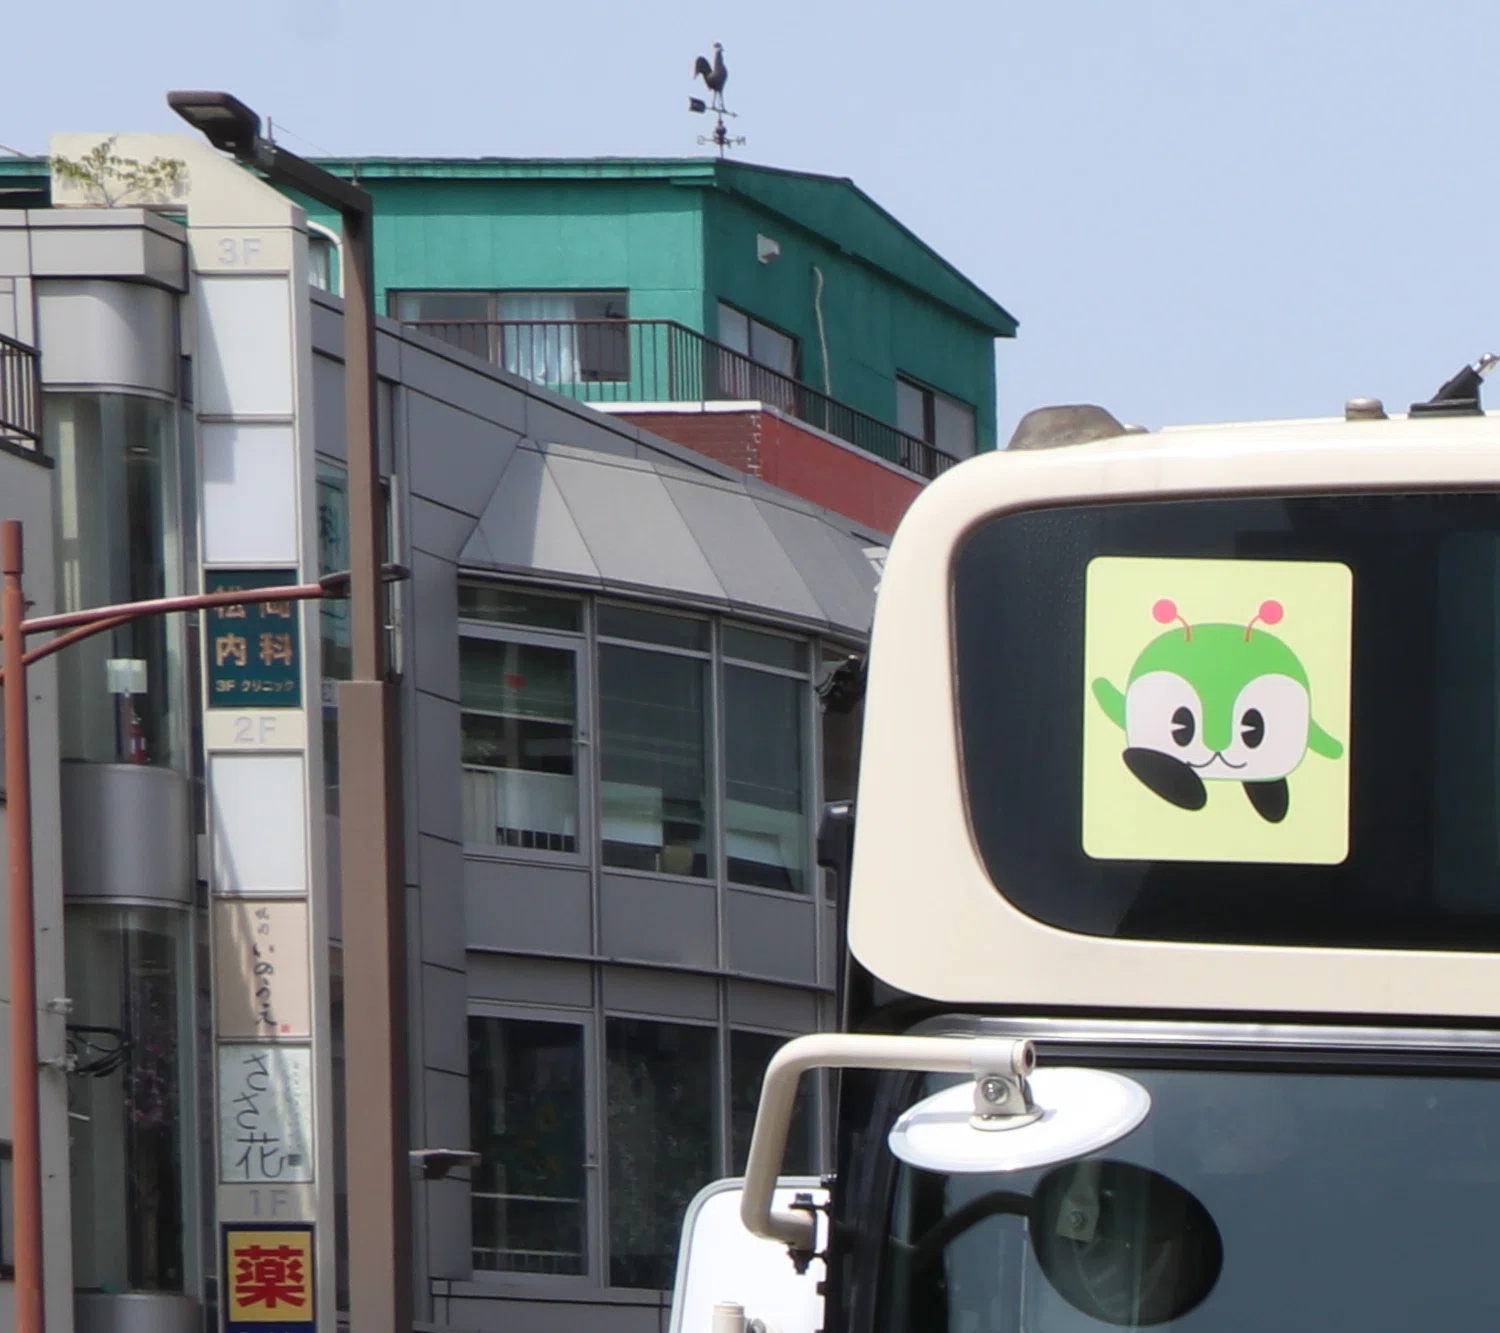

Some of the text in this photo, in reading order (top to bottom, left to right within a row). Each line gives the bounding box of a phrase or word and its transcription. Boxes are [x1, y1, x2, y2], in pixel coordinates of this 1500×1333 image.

[218, 237, 261, 265] 3F
[215, 632, 293, 667] 内科
[215, 680, 236, 692] 3F
[234, 716, 277, 743] 2F
[249, 1189, 288, 1217] 1F
[234, 1245, 306, 1309] 薬
